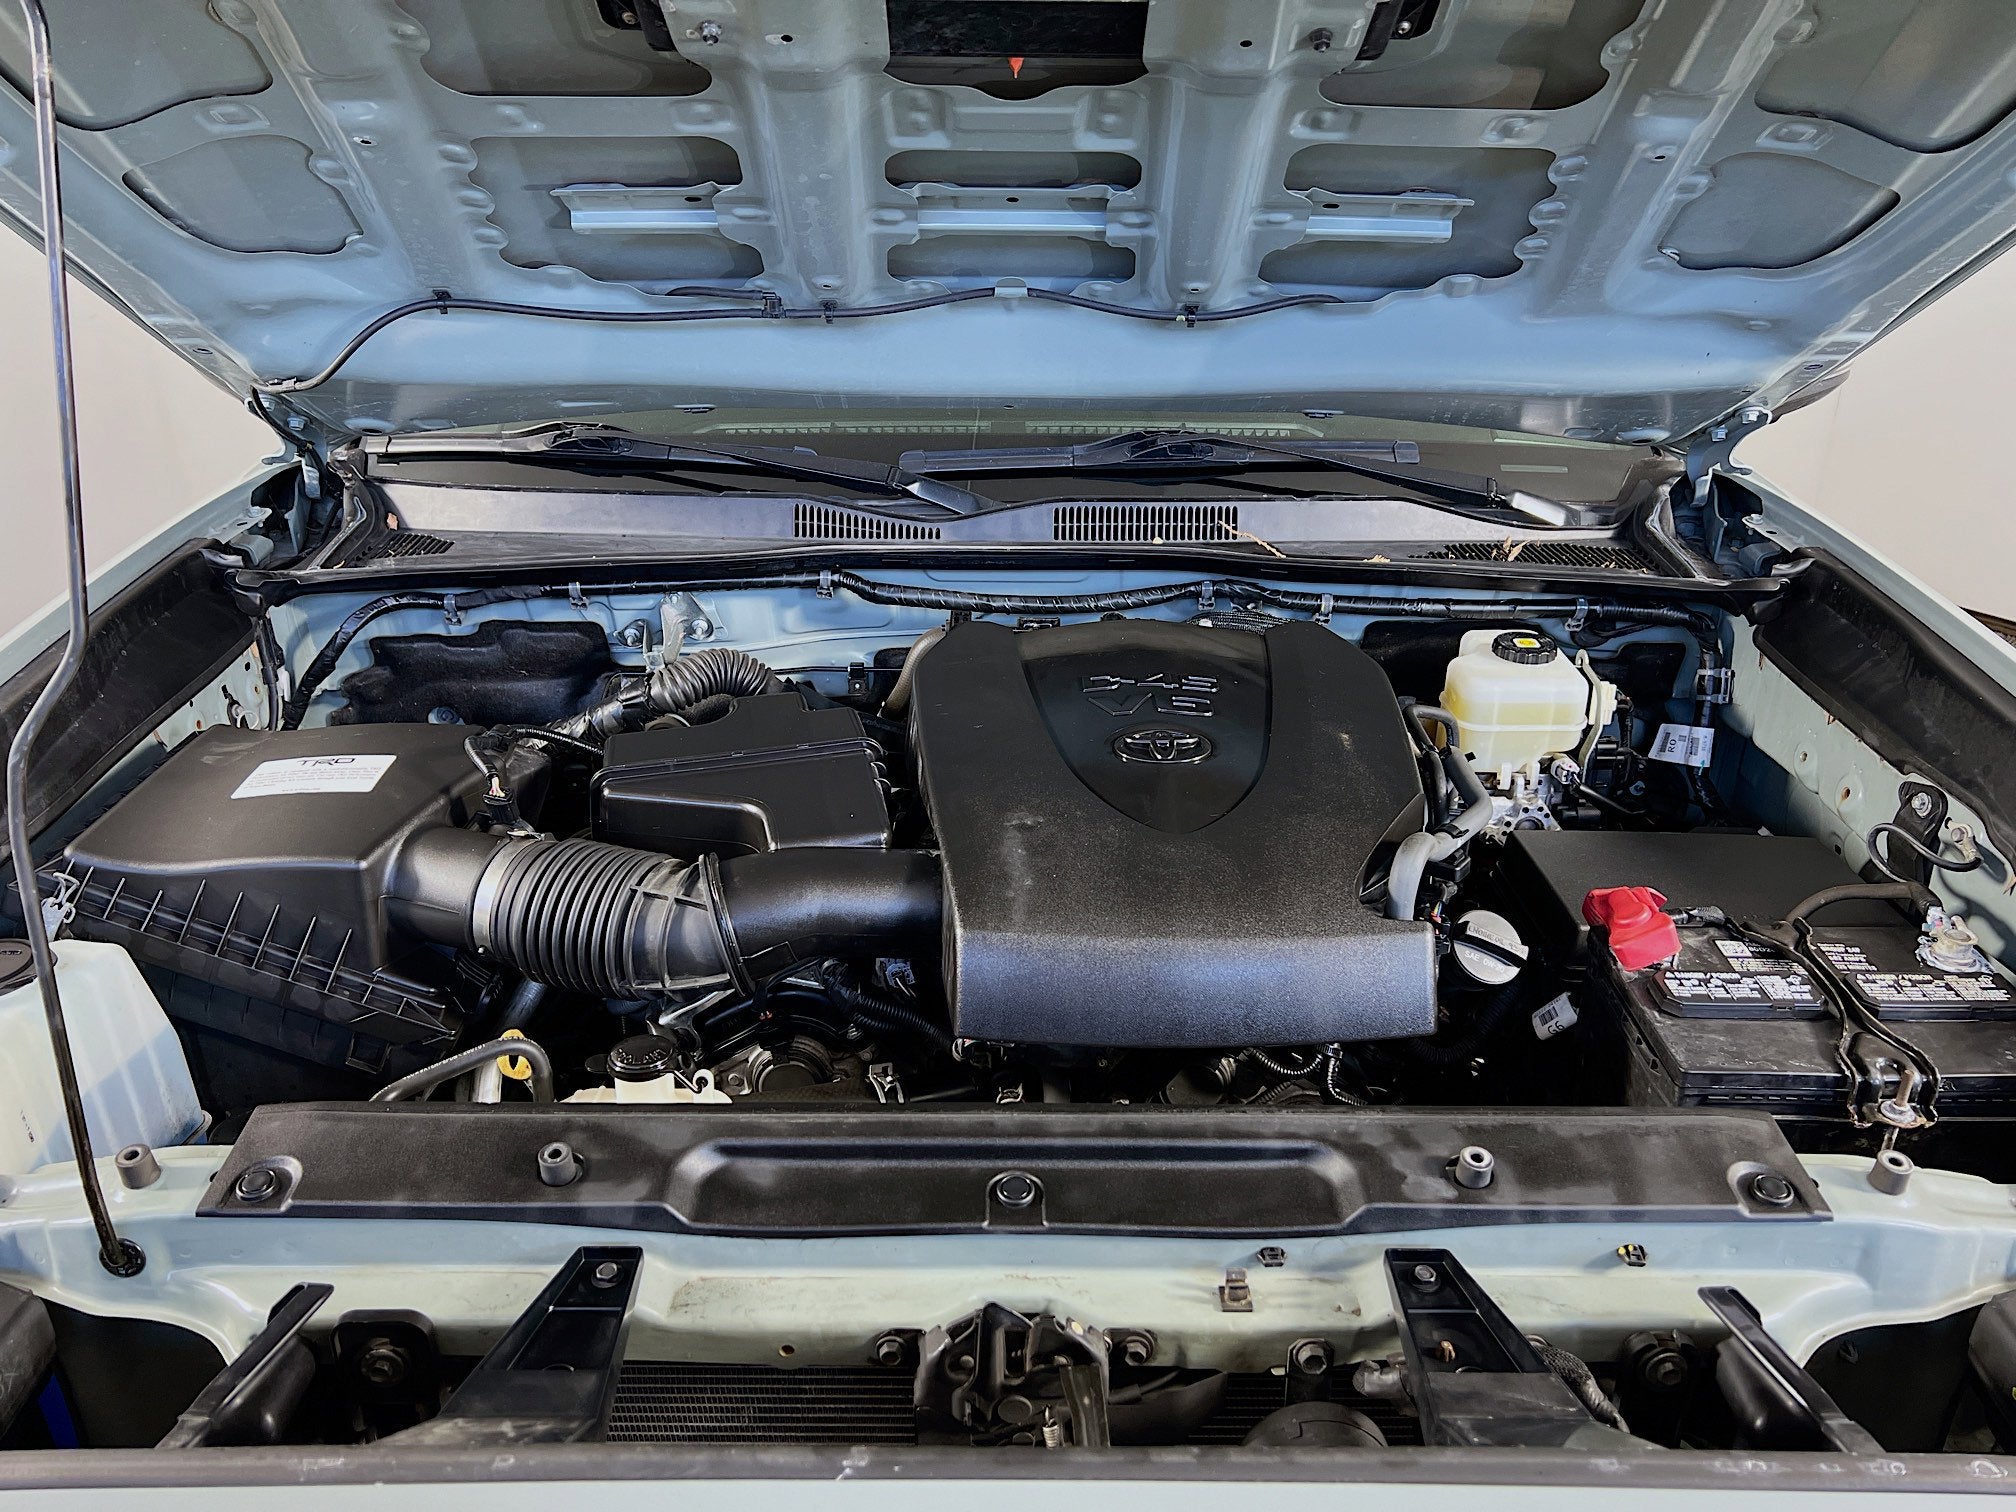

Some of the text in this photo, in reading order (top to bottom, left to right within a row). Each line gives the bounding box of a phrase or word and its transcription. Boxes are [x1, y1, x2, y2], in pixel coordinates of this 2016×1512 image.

[1088, 693, 1215, 717] V6
[297, 757, 356, 767] TRD
[1464, 950, 1506, 973] SAE 0W-20
[1547, 1020, 1566, 1035] G6
